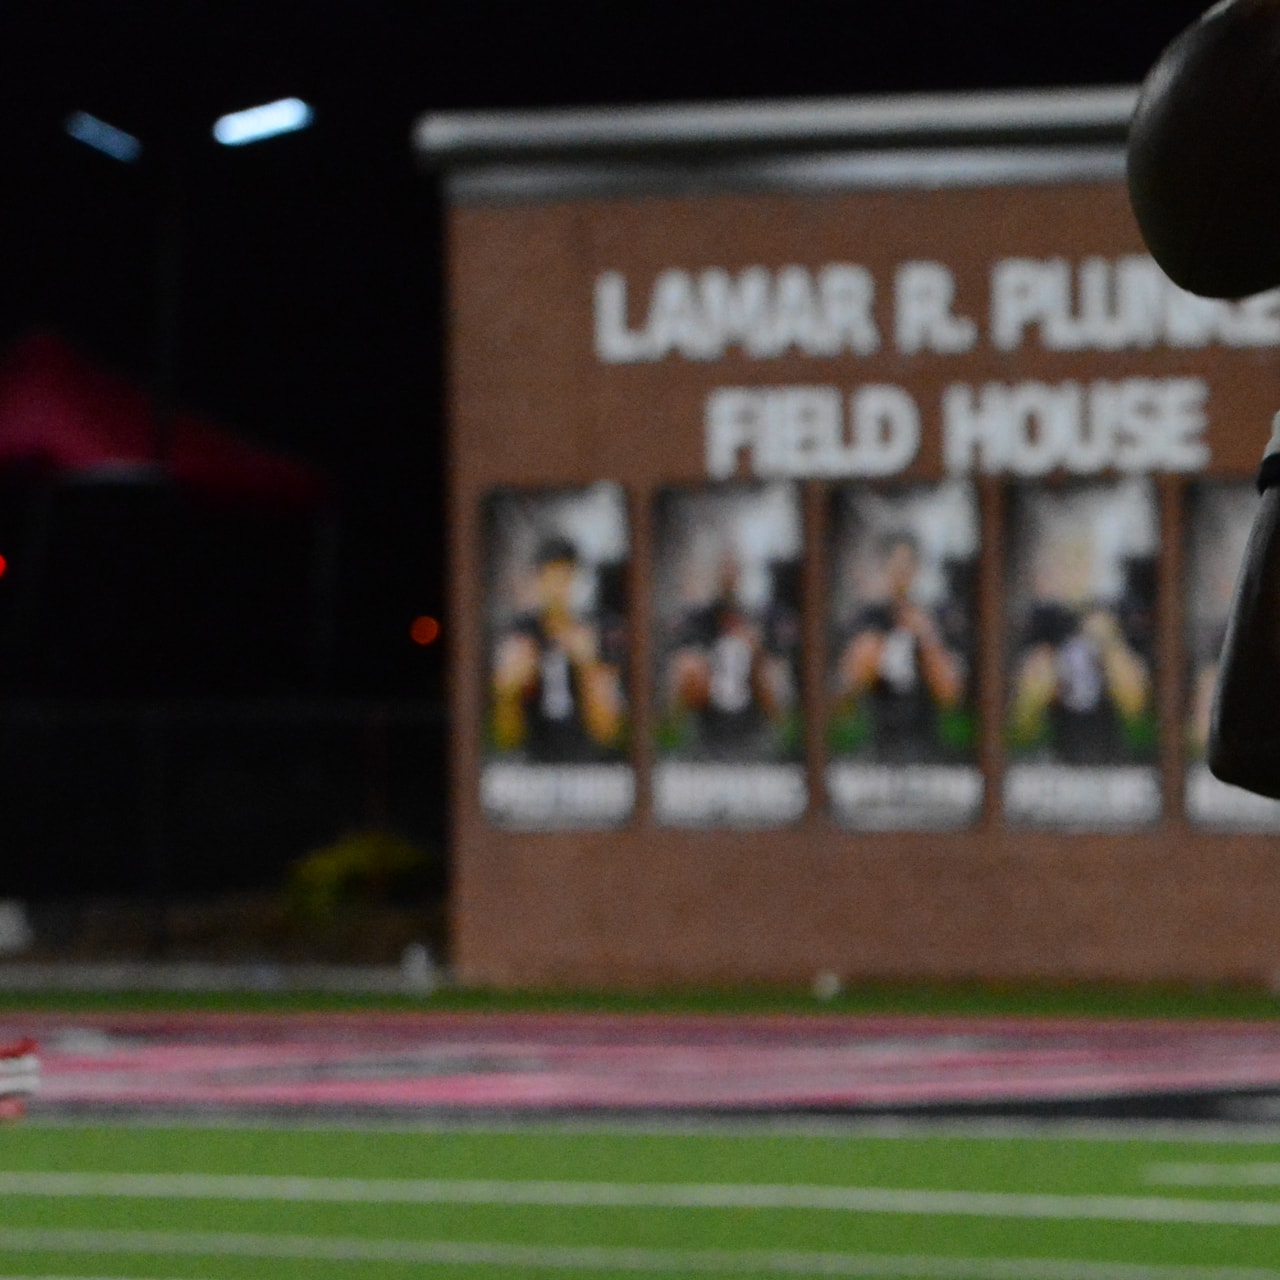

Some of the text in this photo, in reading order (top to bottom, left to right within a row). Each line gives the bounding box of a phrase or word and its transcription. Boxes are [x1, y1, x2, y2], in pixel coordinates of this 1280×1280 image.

[595, 266, 881, 363] LAMAR
[894, 259, 978, 356] R.
[703, 377, 1210, 479] FIELD HOUSE
